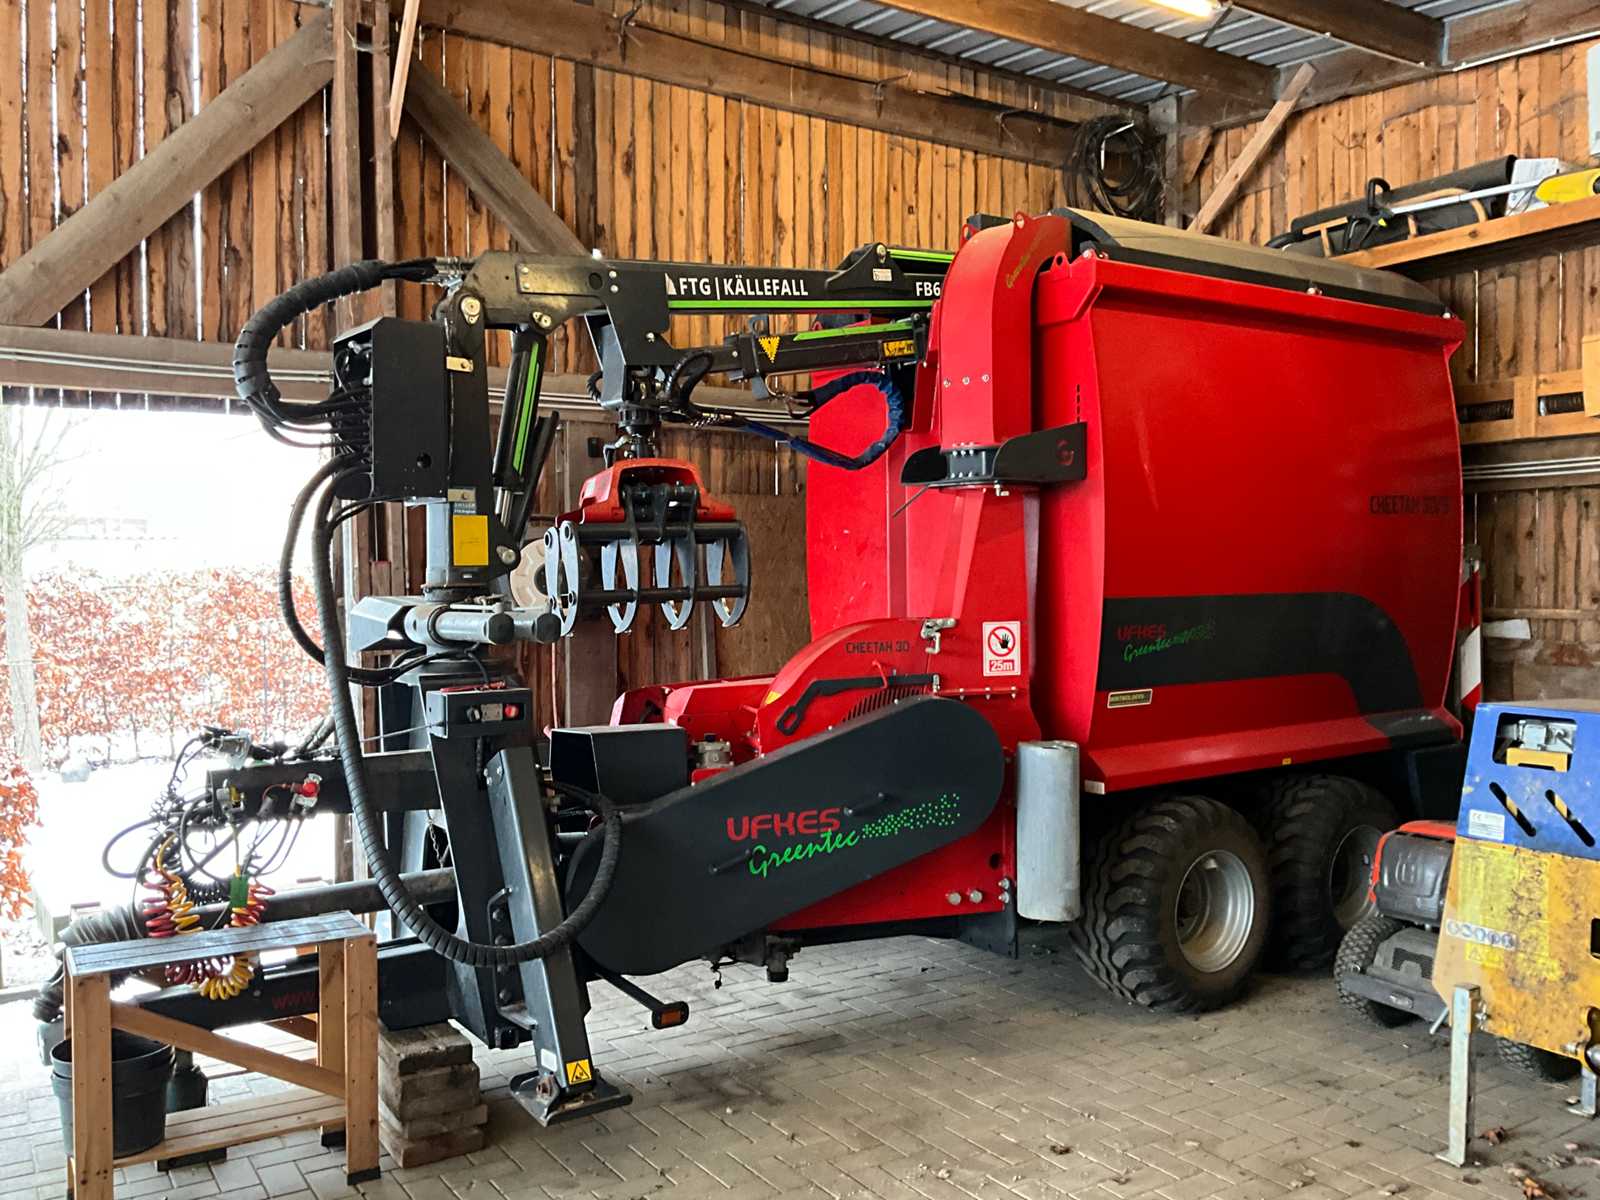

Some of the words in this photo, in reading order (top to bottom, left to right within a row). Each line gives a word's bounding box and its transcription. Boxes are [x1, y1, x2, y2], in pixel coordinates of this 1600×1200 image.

[680, 278, 711, 296] FTG
[724, 274, 808, 296] KÄLLEFALL
[915, 281, 941, 297] FB6
[845, 641, 893, 655] CHEETAH
[990, 661, 1013, 672] 25m
[726, 808, 840, 841] UFKES
[750, 831, 859, 878] Greentec
